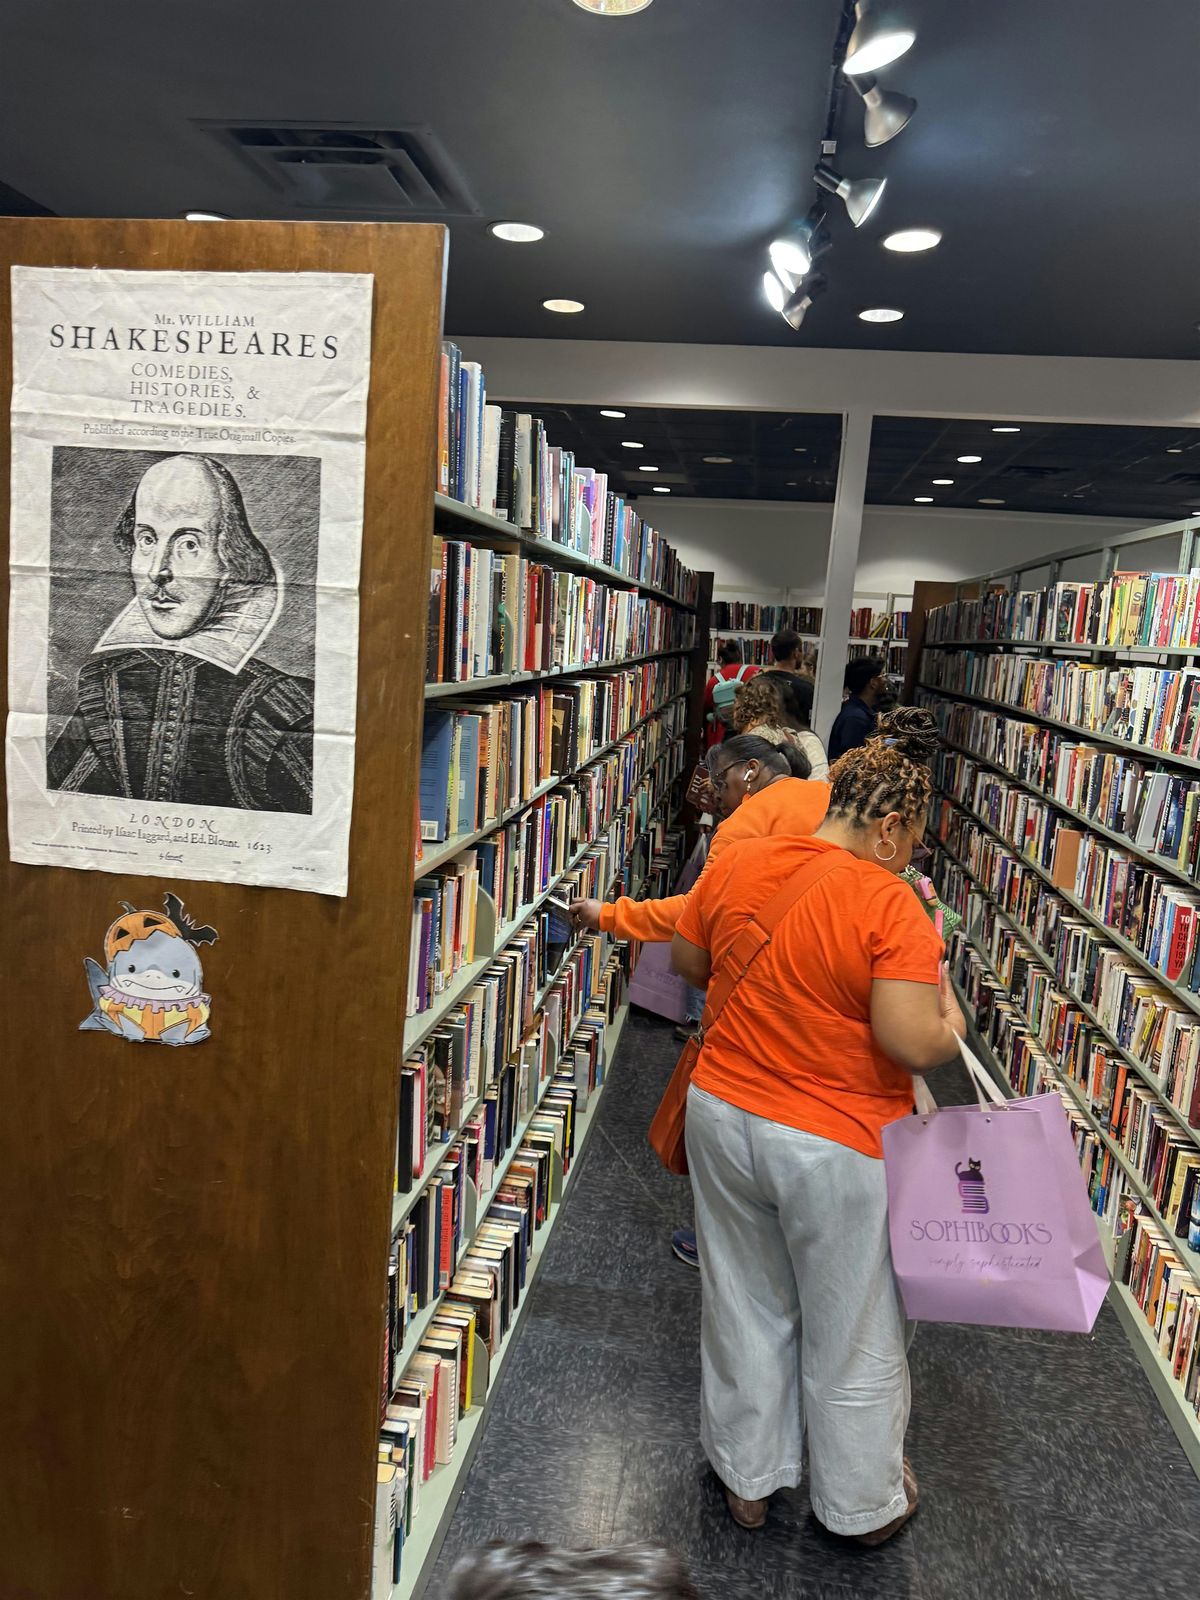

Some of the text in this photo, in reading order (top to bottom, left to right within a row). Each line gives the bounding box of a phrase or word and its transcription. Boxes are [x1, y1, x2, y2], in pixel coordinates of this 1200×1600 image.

[179, 313, 255, 327] WILLIAM
[50, 323, 339, 360] SHAKESPEARES
[131, 362, 234, 383] COMEDIES,
[130, 380, 261, 400] HISTORIES, &
[131, 399, 247, 419] TRAGEDIES.
[129, 813, 219, 834] LONDON
[909, 1219, 1053, 1245] SOPHIBOOKS
